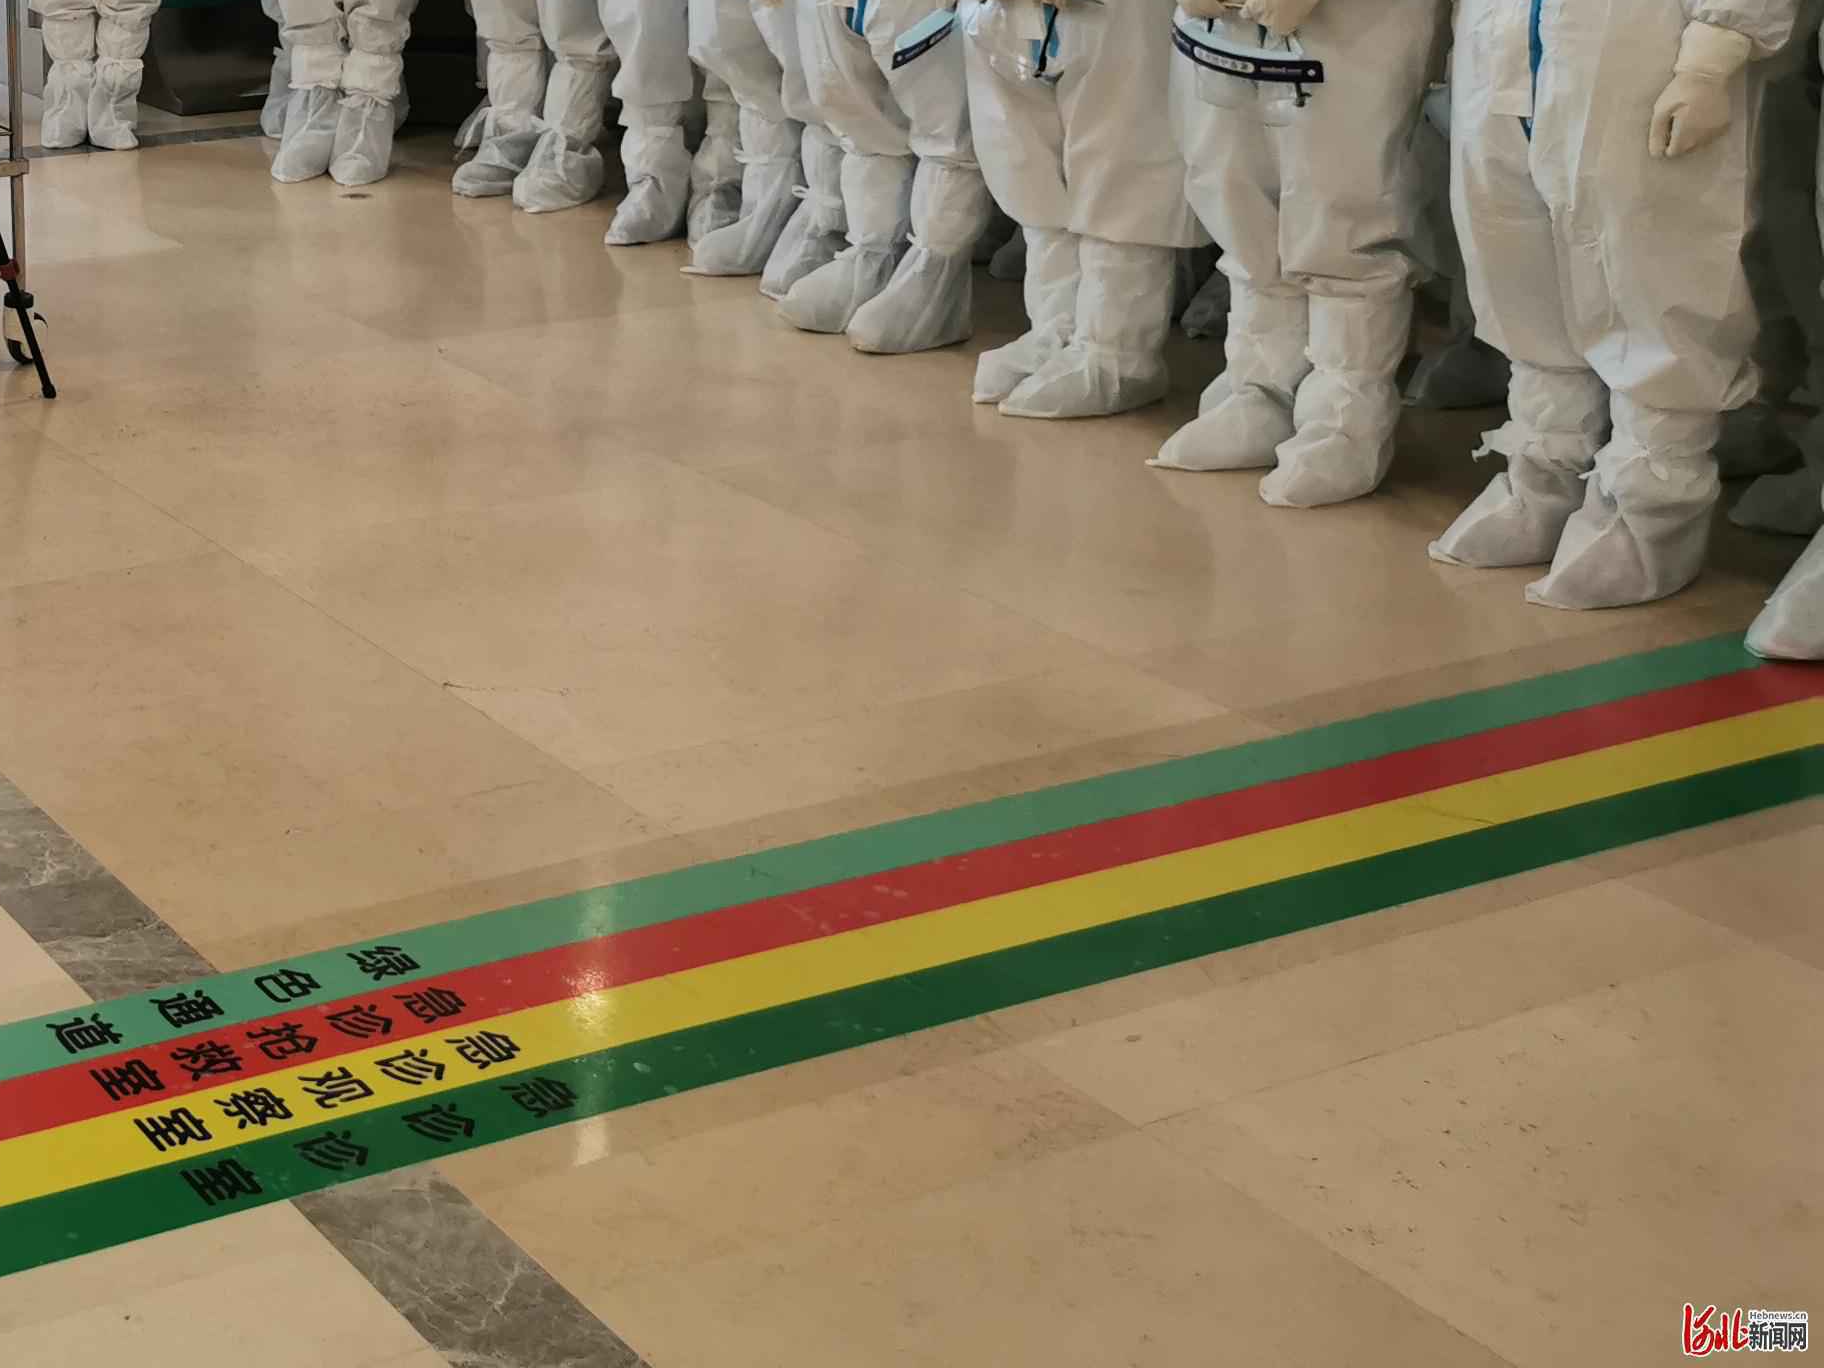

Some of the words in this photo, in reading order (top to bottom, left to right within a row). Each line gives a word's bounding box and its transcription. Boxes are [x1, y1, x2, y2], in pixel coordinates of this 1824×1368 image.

[45, 944, 422, 1055] 绿色通道
[88, 985, 471, 1102] 急诊抢救室
[133, 1029, 523, 1152] 急诊观察室
[179, 1075, 580, 1206] 急诊诊室
